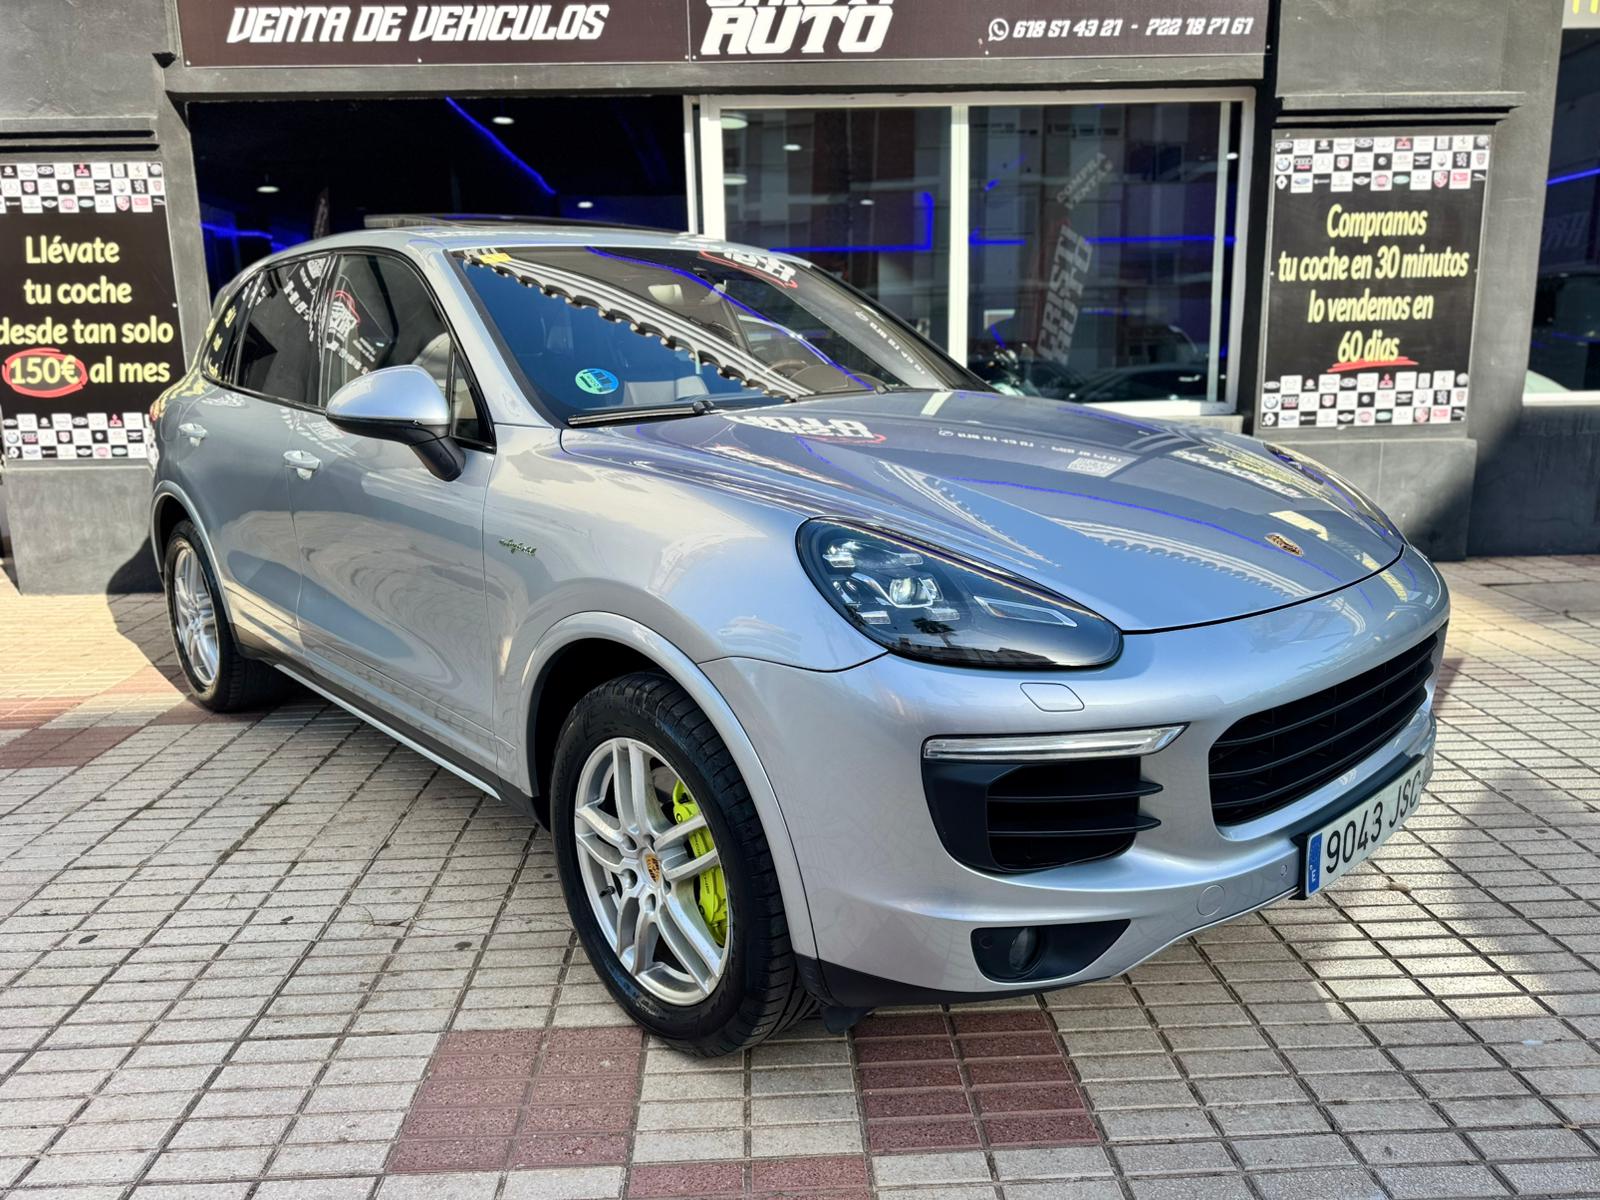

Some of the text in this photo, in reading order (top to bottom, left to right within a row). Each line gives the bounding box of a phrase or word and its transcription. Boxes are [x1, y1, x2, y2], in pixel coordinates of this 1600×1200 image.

[227, 4, 610, 43] VENTA DE VEHICULOS
[700, 5, 893, 55] AUTO
[1012, 19, 1046, 38] 618
[1049, 19, 1071, 37] 51
[1073, 18, 1100, 37] 43
[1100, 19, 1123, 36] 21
[1145, 17, 1183, 36] 722
[1185, 17, 1206, 35] 18
[1206, 17, 1231, 35] 71
[1231, 17, 1254, 35] 61
[1327, 203, 1428, 244] Compramos
[25, 235, 120, 264] Llévate
[1278, 244, 1470, 282] tu coche en 30 minutos
[23, 275, 133, 305] tu coche
[1307, 287, 1434, 323] lo vendemos en
[0, 315, 174, 345] desde tan solo
[1337, 329, 1400, 363] 60 dias
[10, 355, 171, 384] 150€ al mes
[1326, 769, 1421, 873] 9043 JSC
